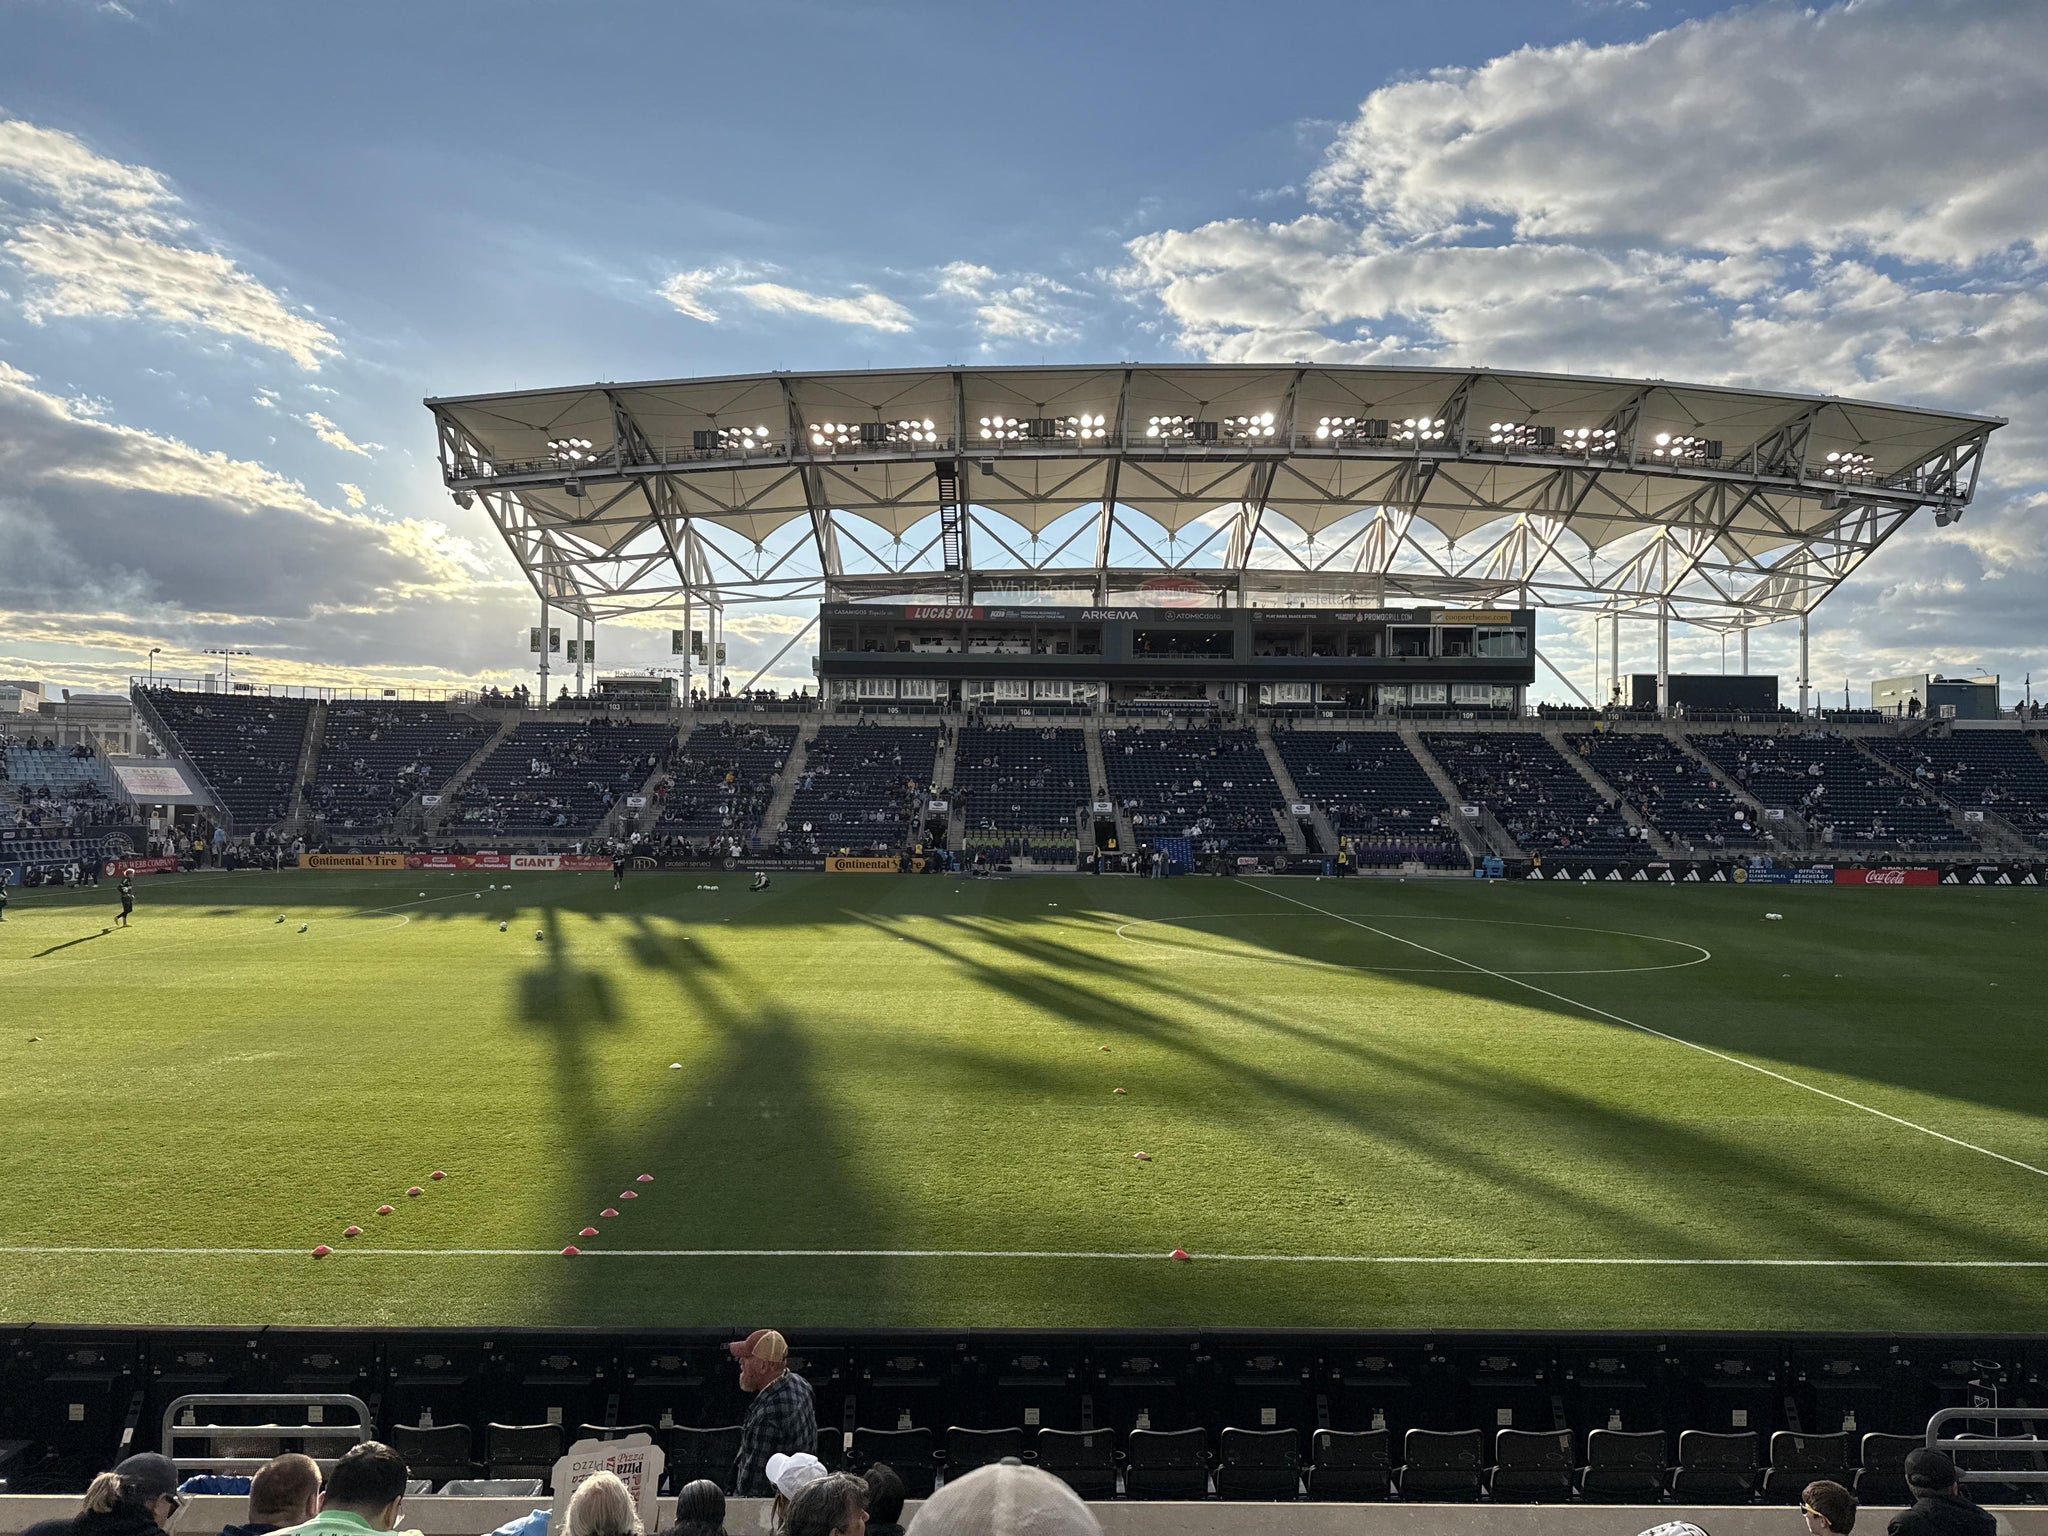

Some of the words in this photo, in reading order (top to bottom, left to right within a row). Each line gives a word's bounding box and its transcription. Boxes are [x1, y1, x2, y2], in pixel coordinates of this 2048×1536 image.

[990, 578, 1076, 599] Whirlpool
[914, 608, 953, 620] LUCAS
[955, 607, 974, 619] OIL
[1081, 610, 1139, 620] ARKEMA
[308, 855, 364, 867] Continental
[374, 855, 397, 866] Tire
[514, 858, 555, 867] GIANT
[834, 858, 890, 871] Continental
[1865, 870, 1907, 884] Coca-Cola
[617, 1453, 645, 1463] Pizza
